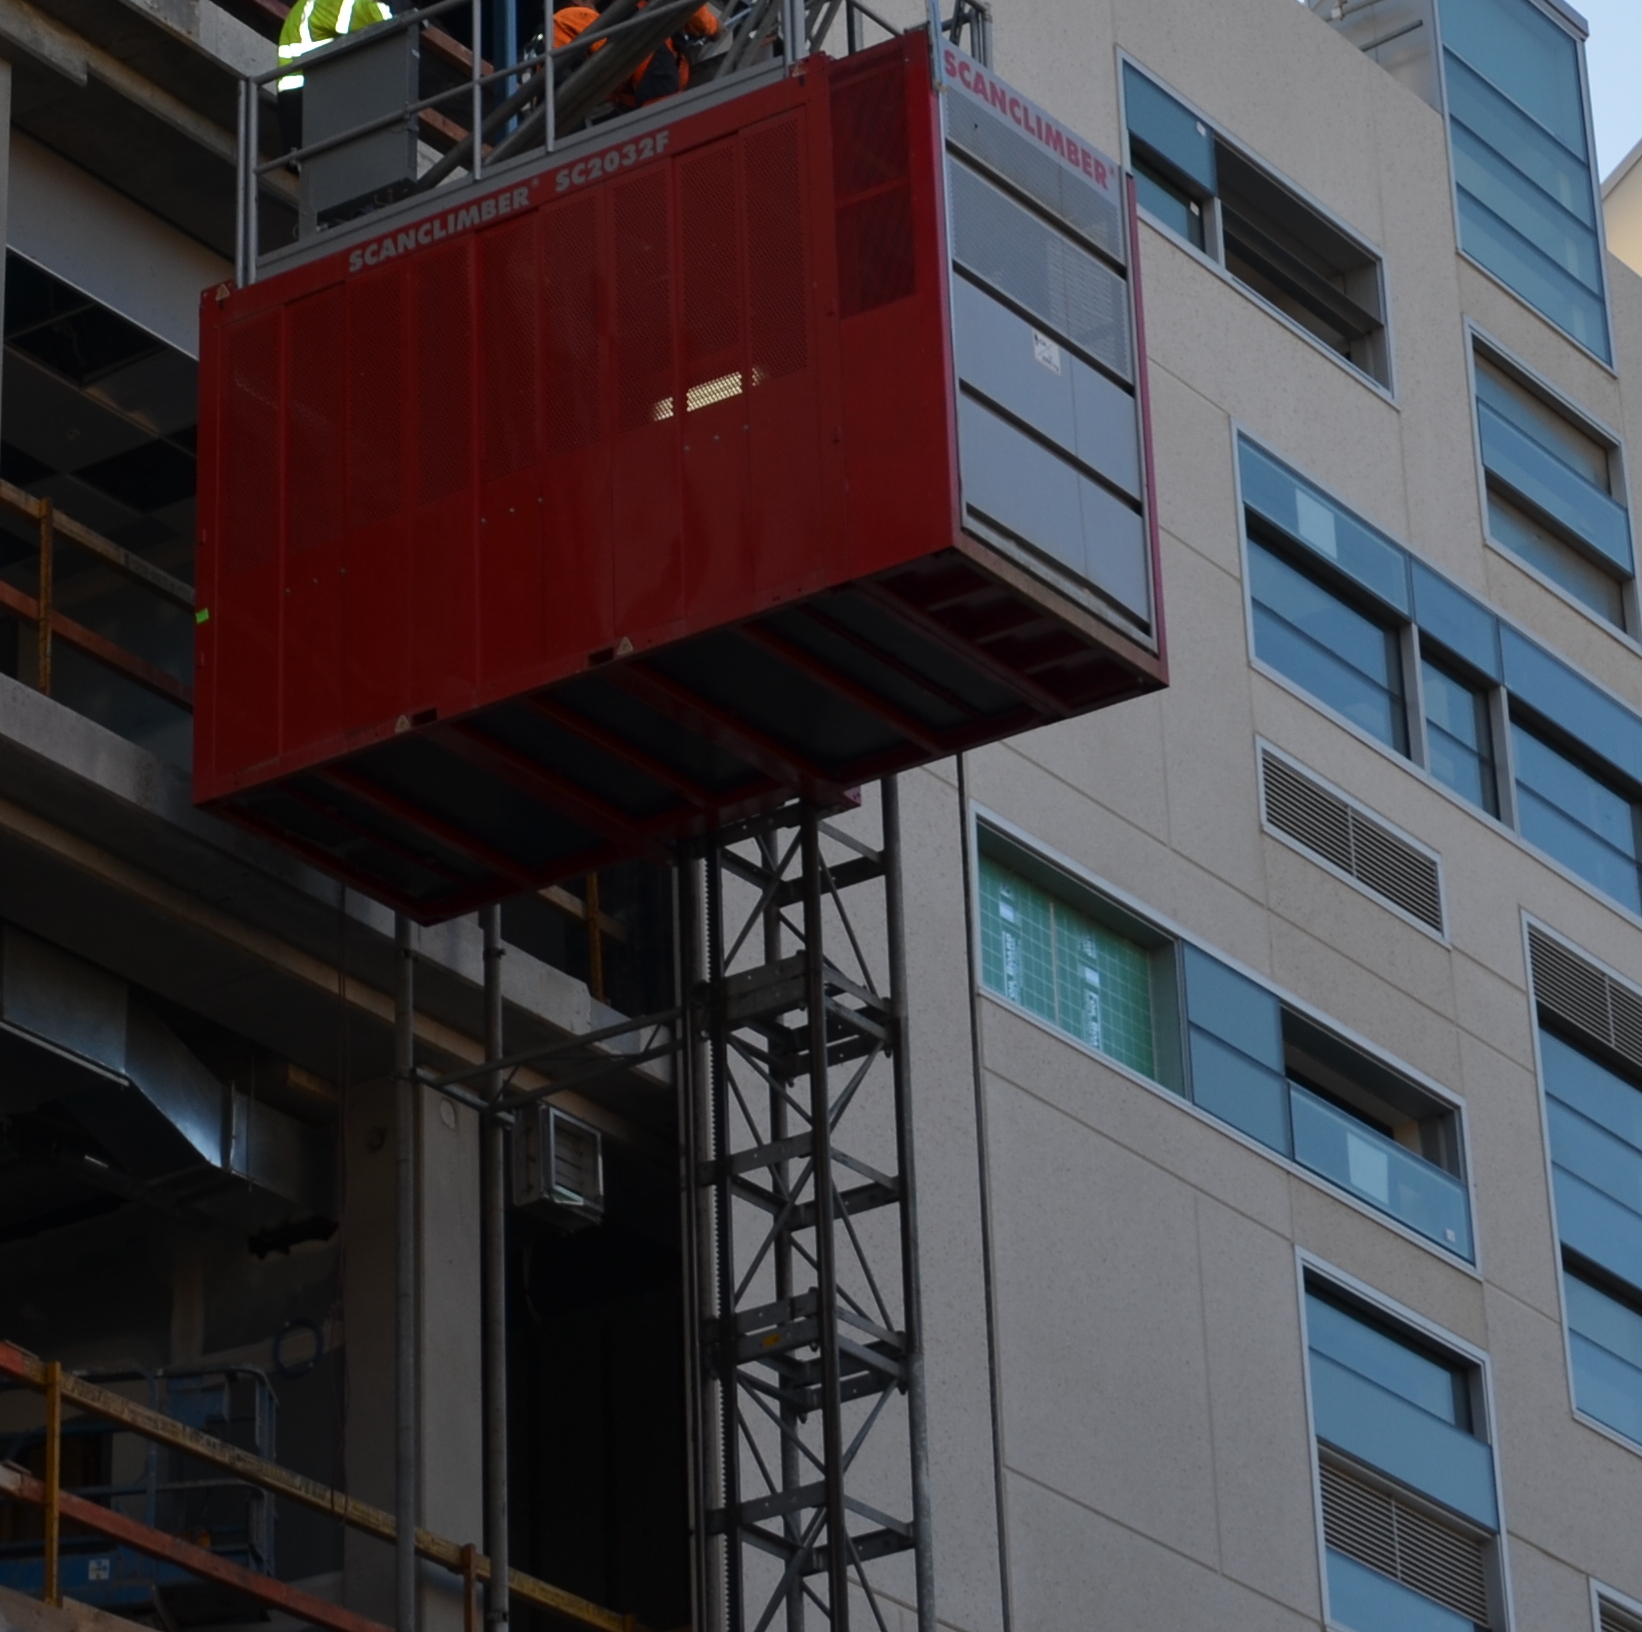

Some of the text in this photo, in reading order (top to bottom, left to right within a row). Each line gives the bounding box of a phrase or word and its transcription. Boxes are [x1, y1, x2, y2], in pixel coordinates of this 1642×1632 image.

[943, 49, 1109, 192] SCANCLIMBER
[348, 129, 670, 273] SCANCLIMBER SC2032F
